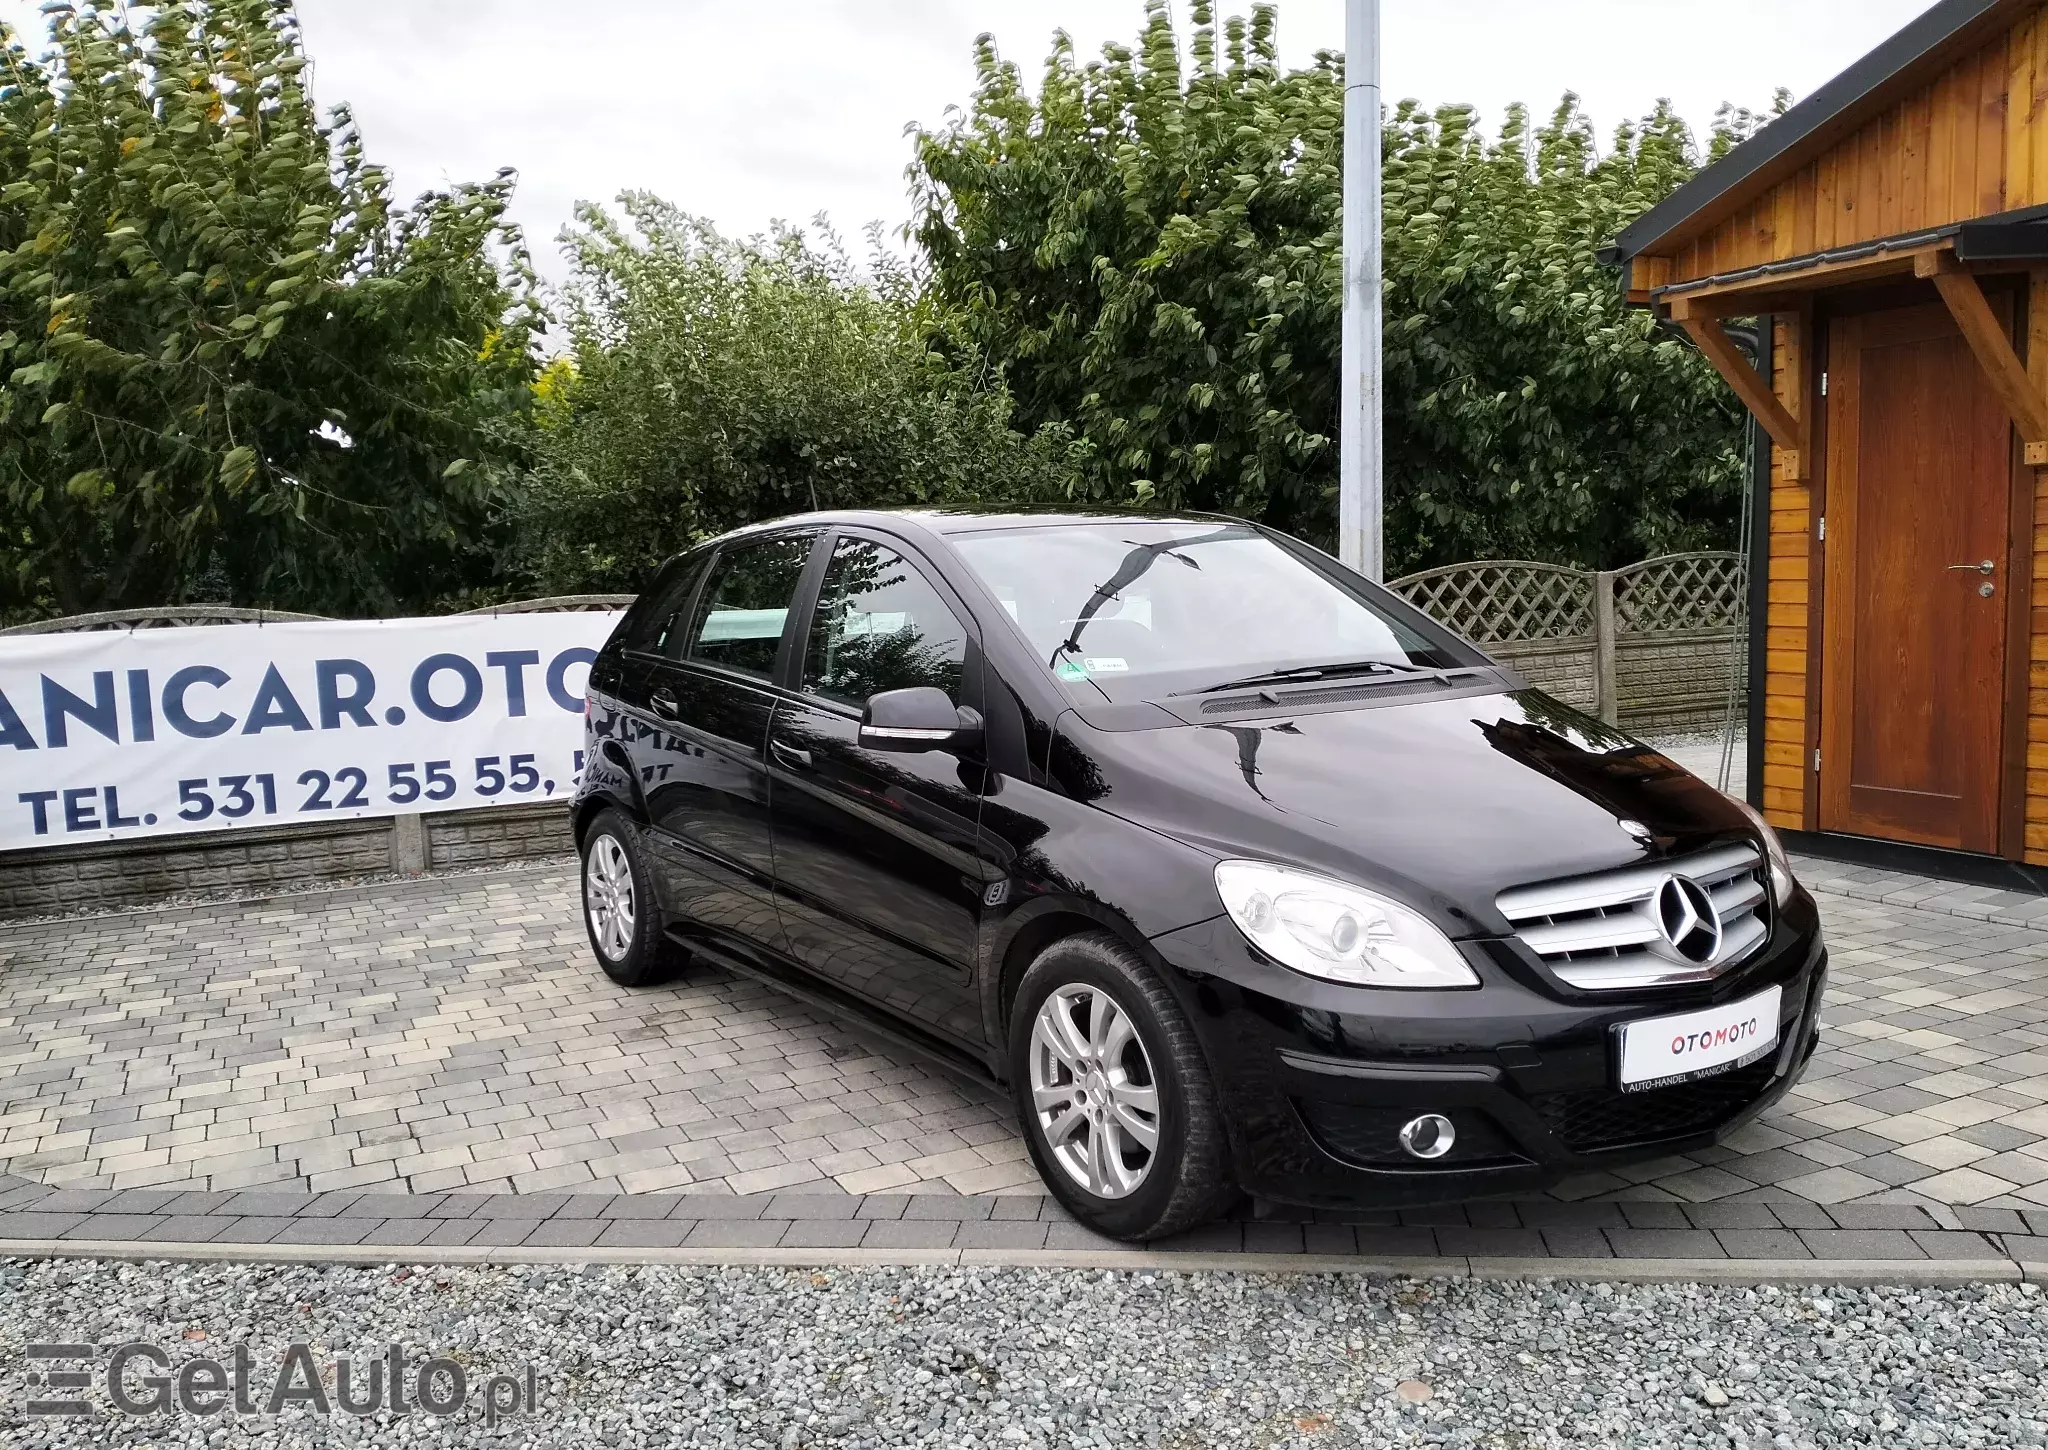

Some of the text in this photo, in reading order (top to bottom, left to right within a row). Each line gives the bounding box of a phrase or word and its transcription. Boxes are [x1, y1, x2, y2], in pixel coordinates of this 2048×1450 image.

[18, 785, 157, 835] TEL.
[178, 774, 276, 821] 531
[298, 767, 369, 812] 22
[387, 760, 457, 804] 55
[475, 754, 555, 796] 55,
[1671, 1017, 1757, 1055] OTOMOTO
[1628, 1075, 1688, 1093] AUTO-HANDEL
[1693, 1062, 1733, 1079] "MANICAR"
